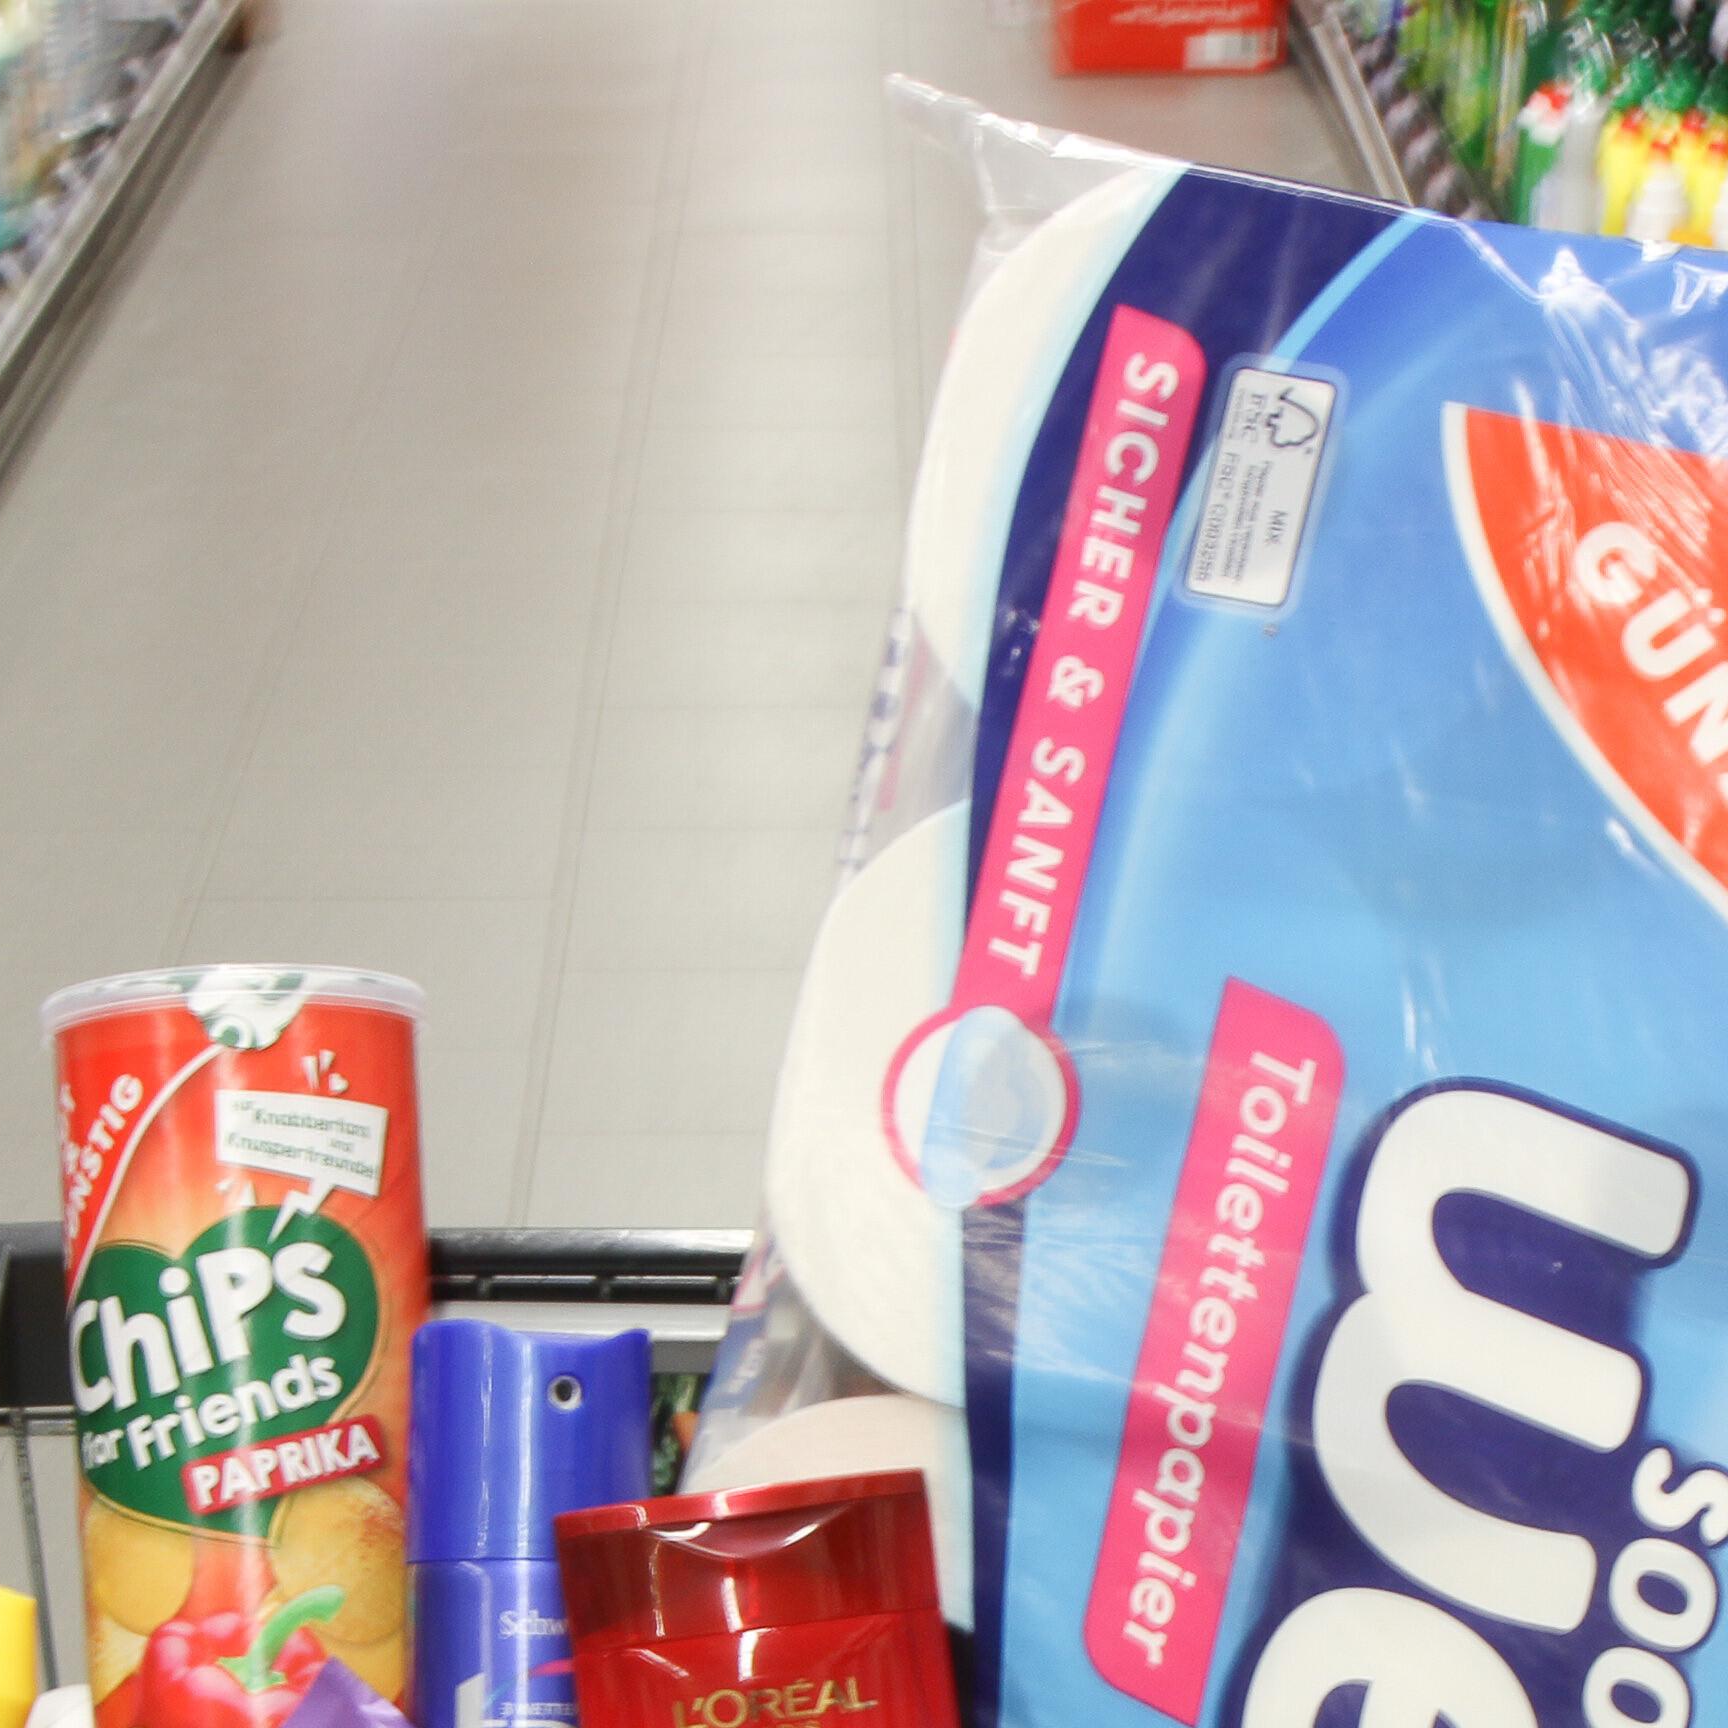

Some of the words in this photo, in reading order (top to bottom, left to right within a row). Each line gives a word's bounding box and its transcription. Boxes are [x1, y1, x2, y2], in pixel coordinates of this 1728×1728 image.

[1065, 352, 1180, 630] SICHER
[1046, 655, 1106, 709] &
[986, 736, 1087, 981] SANFT
[126, 1352, 342, 1472] Friends
[1122, 1050, 1318, 1668] Toilettenpapier
[189, 1424, 380, 1505] PAPRIKA
